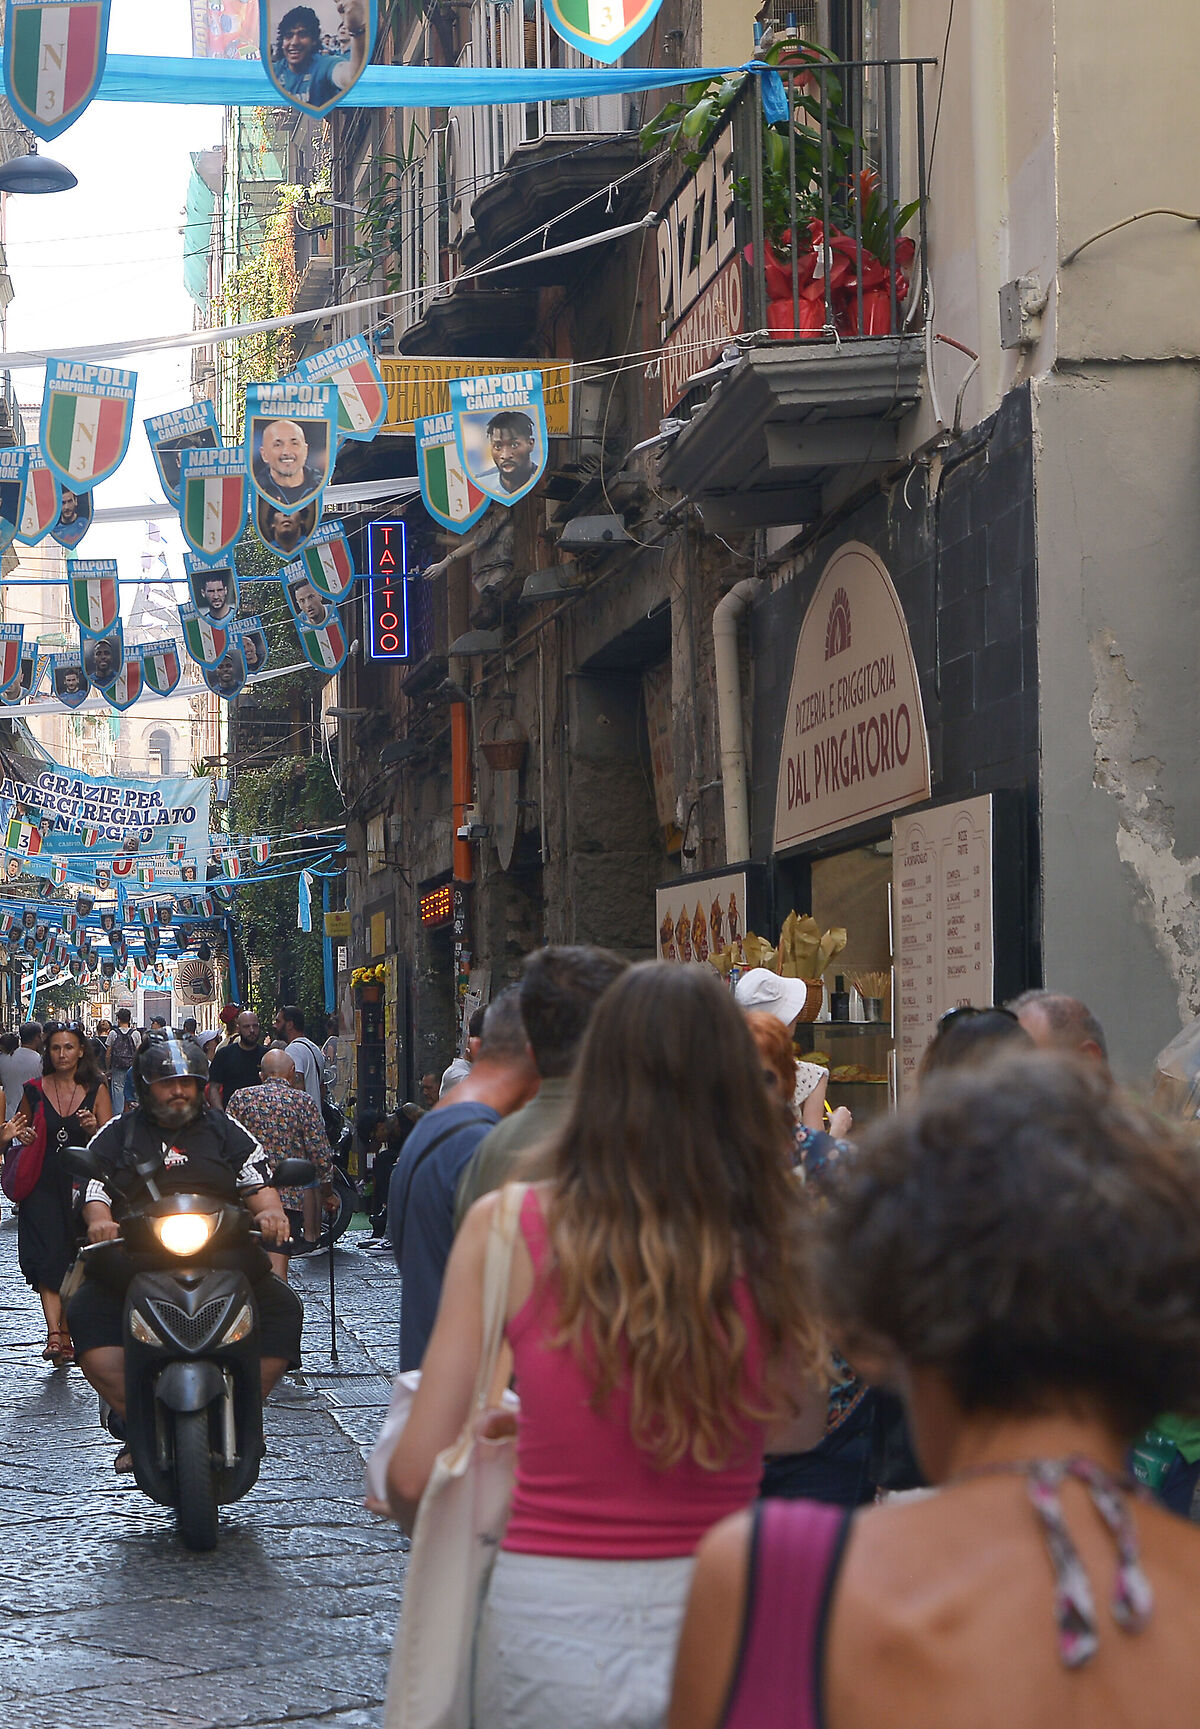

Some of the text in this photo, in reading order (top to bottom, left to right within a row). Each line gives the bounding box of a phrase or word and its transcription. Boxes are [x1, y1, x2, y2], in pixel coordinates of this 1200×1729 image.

[601, 6, 612, 28] 3
[42, 43, 65, 71] N
[44, 90, 55, 110] 3
[657, 121, 736, 343] PIZZE
[304, 338, 363, 374] NAPOLI
[306, 362, 343, 384] CAMPIONE
[348, 349, 369, 366] ITALIA
[56, 362, 131, 388] NAPOLI
[460, 374, 534, 397] NAPOLI
[48, 379, 134, 400] CAMPIONE IN ITALIA
[256, 384, 331, 404] NAPOLI
[342, 388, 359, 407] N
[260, 400, 325, 418] CAMPIONE
[466, 391, 530, 410] CAMPIONE
[150, 402, 209, 433] NAPOLI
[75, 422, 97, 443] N
[157, 416, 208, 441] CAMPIONE
[76, 456, 87, 471] 3
[188, 448, 245, 467] NAPOLI
[449, 465, 465, 487] N
[206, 501, 221, 520] N
[455, 498, 463, 512] 3
[26, 517, 34, 529] 3
[208, 531, 217, 545] 3
[73, 560, 116, 572] NAPOLI
[332, 579, 338, 589] 3
[379, 527, 399, 651] TATTOO
[796, 653, 896, 737] PIZZERIA E FRIGGITORIA
[787, 703, 911, 811] DAL PVRGATORIO
[38, 772, 164, 809] GRAZIE PER
[81, 804, 198, 828] REGALATO
[19, 834, 29, 848] 3
